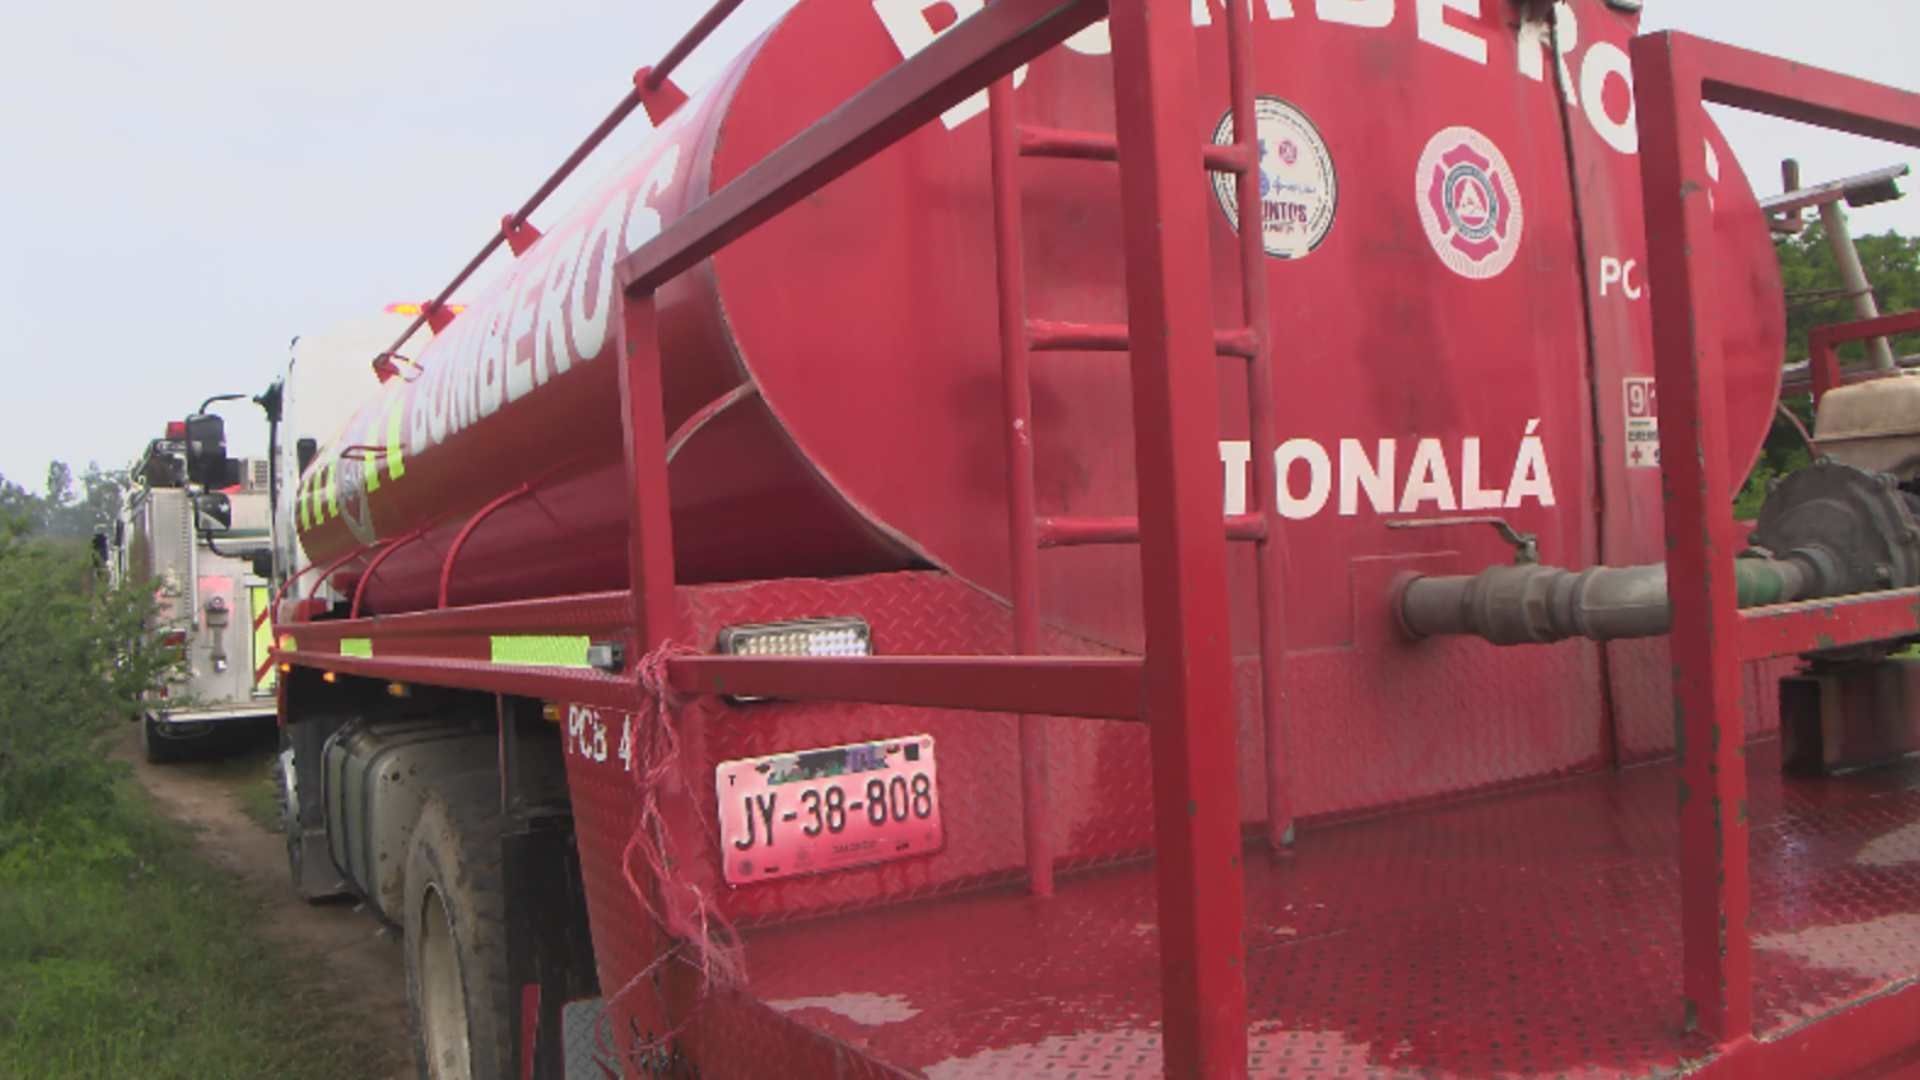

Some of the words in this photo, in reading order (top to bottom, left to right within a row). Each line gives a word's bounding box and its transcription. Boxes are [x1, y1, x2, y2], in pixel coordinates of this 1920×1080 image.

[1218, 418, 1555, 520] TONALÁ
[569, 704, 607, 762] PCB
[728, 774, 737, 787] T
[735, 772, 932, 850] JY-38-808
